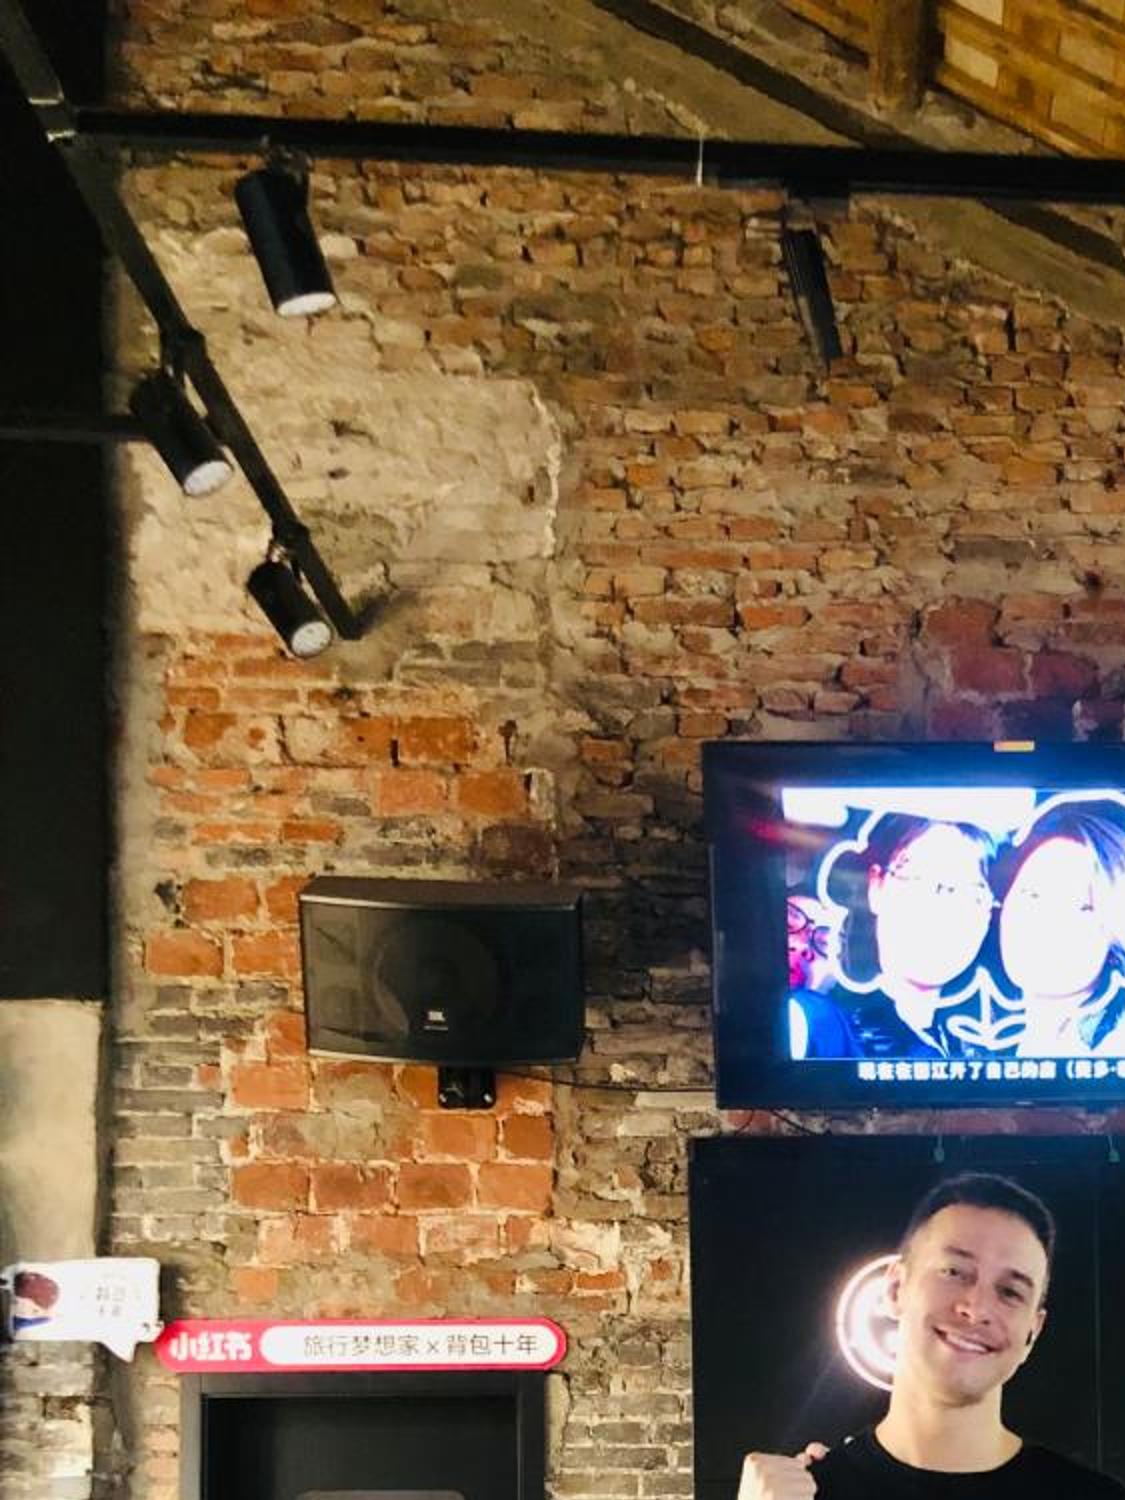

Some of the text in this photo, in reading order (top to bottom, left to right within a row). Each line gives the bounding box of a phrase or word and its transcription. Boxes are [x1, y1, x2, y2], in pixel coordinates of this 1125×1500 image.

[169, 1331, 252, 1361] 小红书
[303, 1334, 419, 1357] 旅行梦想家
[447, 1334, 538, 1356] 背包十年
